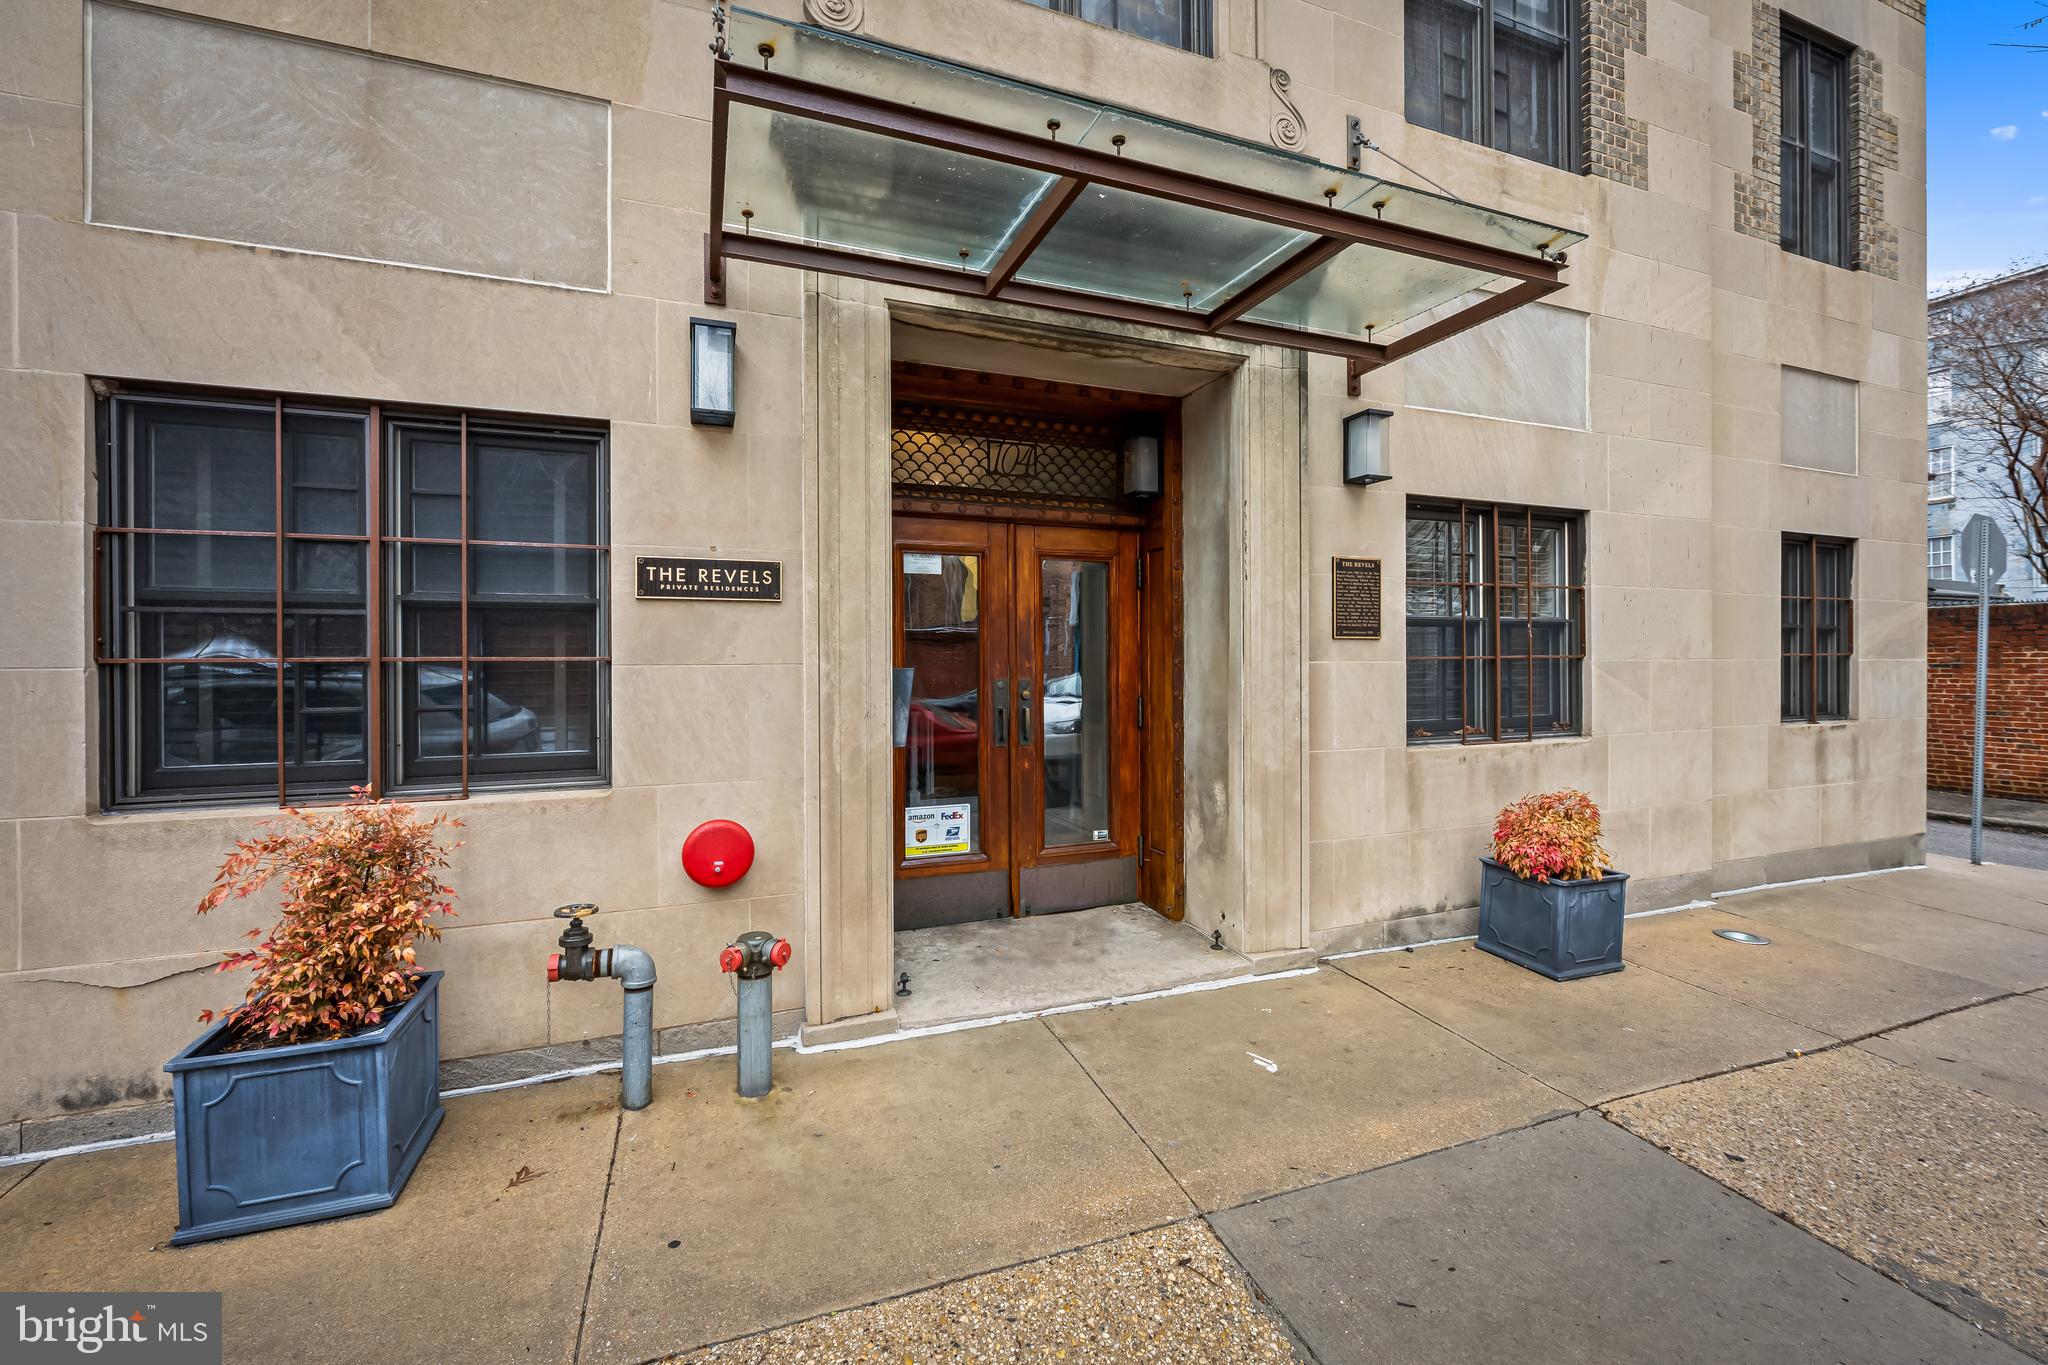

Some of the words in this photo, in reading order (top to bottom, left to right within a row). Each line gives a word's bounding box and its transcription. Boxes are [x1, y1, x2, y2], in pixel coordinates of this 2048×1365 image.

[646, 566, 686, 582] THE
[698, 568, 772, 585] REVELS
[908, 813, 935, 821] amazon
[941, 811, 964, 821] FedEx
